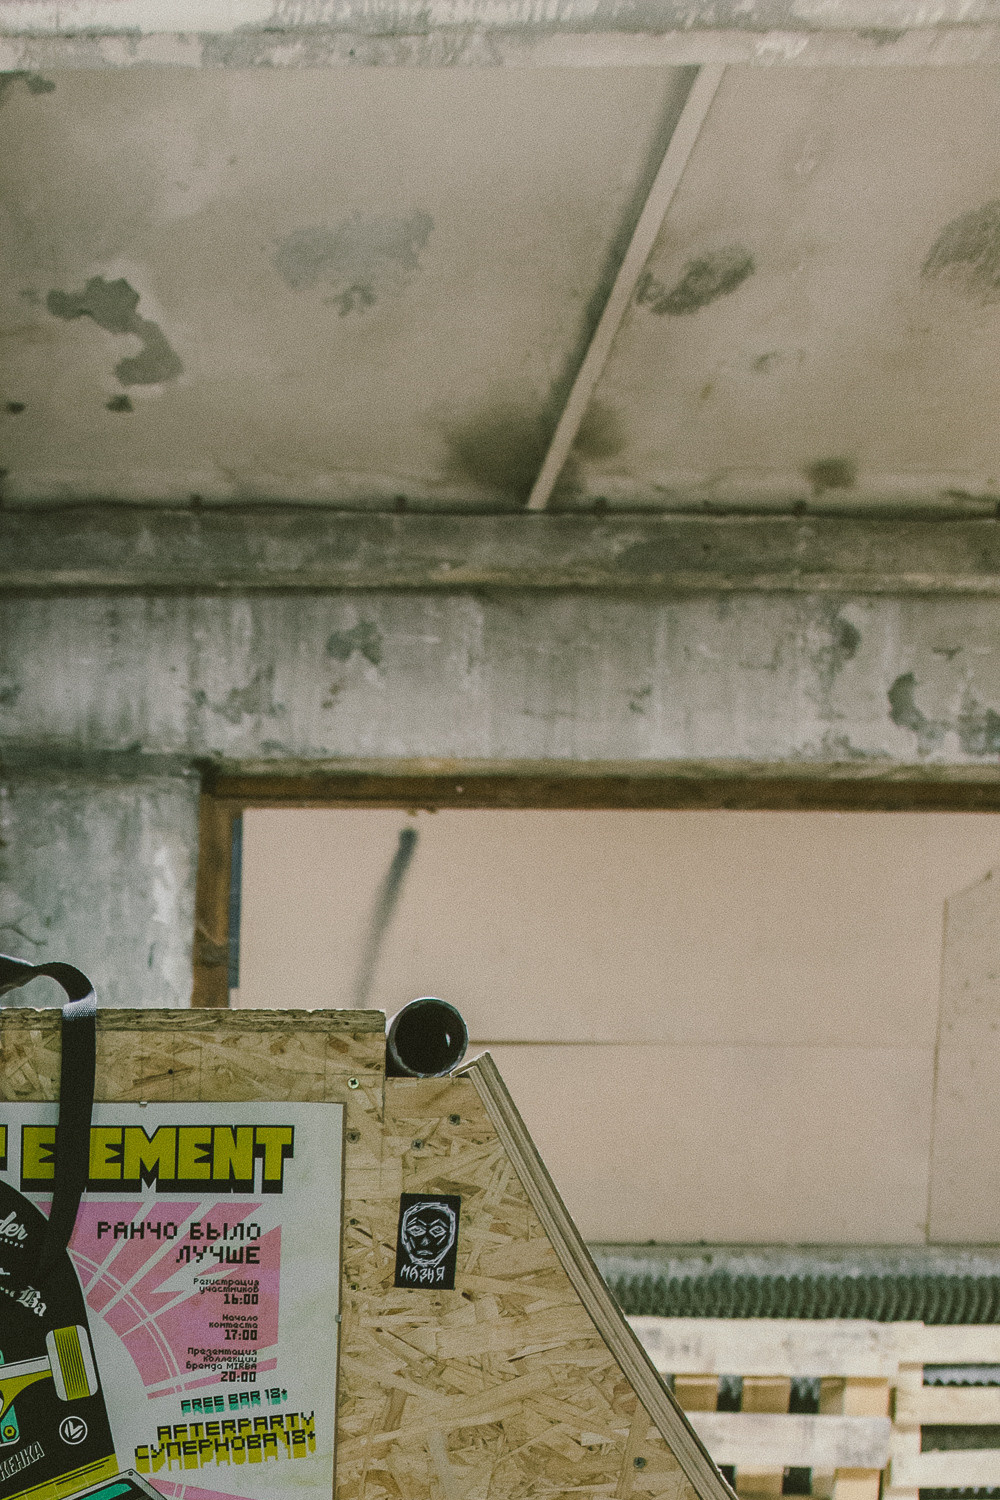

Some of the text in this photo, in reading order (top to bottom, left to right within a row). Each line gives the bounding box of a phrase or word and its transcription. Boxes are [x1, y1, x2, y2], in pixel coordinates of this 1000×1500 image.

[20, 1124, 296, 1192] EEMENT
[97, 1221, 261, 1241] РАНЧО БЫЛО
[175, 1245, 261, 1264] ЛУЧШЕ
[400, 1264, 446, 1283] МАЗНЯ
[193, 1278, 260, 1286] Регистрация
[199, 1286, 260, 1294] участников
[223, 1293, 259, 1305] 16:00
[224, 1329, 258, 1341] 17:00
[187, 1347, 258, 1357] Презентация
[203, 1355, 258, 1363] коллекции
[220, 1371, 257, 1383] 20:00
[180, 1387, 288, 1412] FREE BAR 18+
[157, 1410, 315, 1441] AFTERPARTY
[134, 1428, 316, 1460] СУПЕРНОВА 18+
